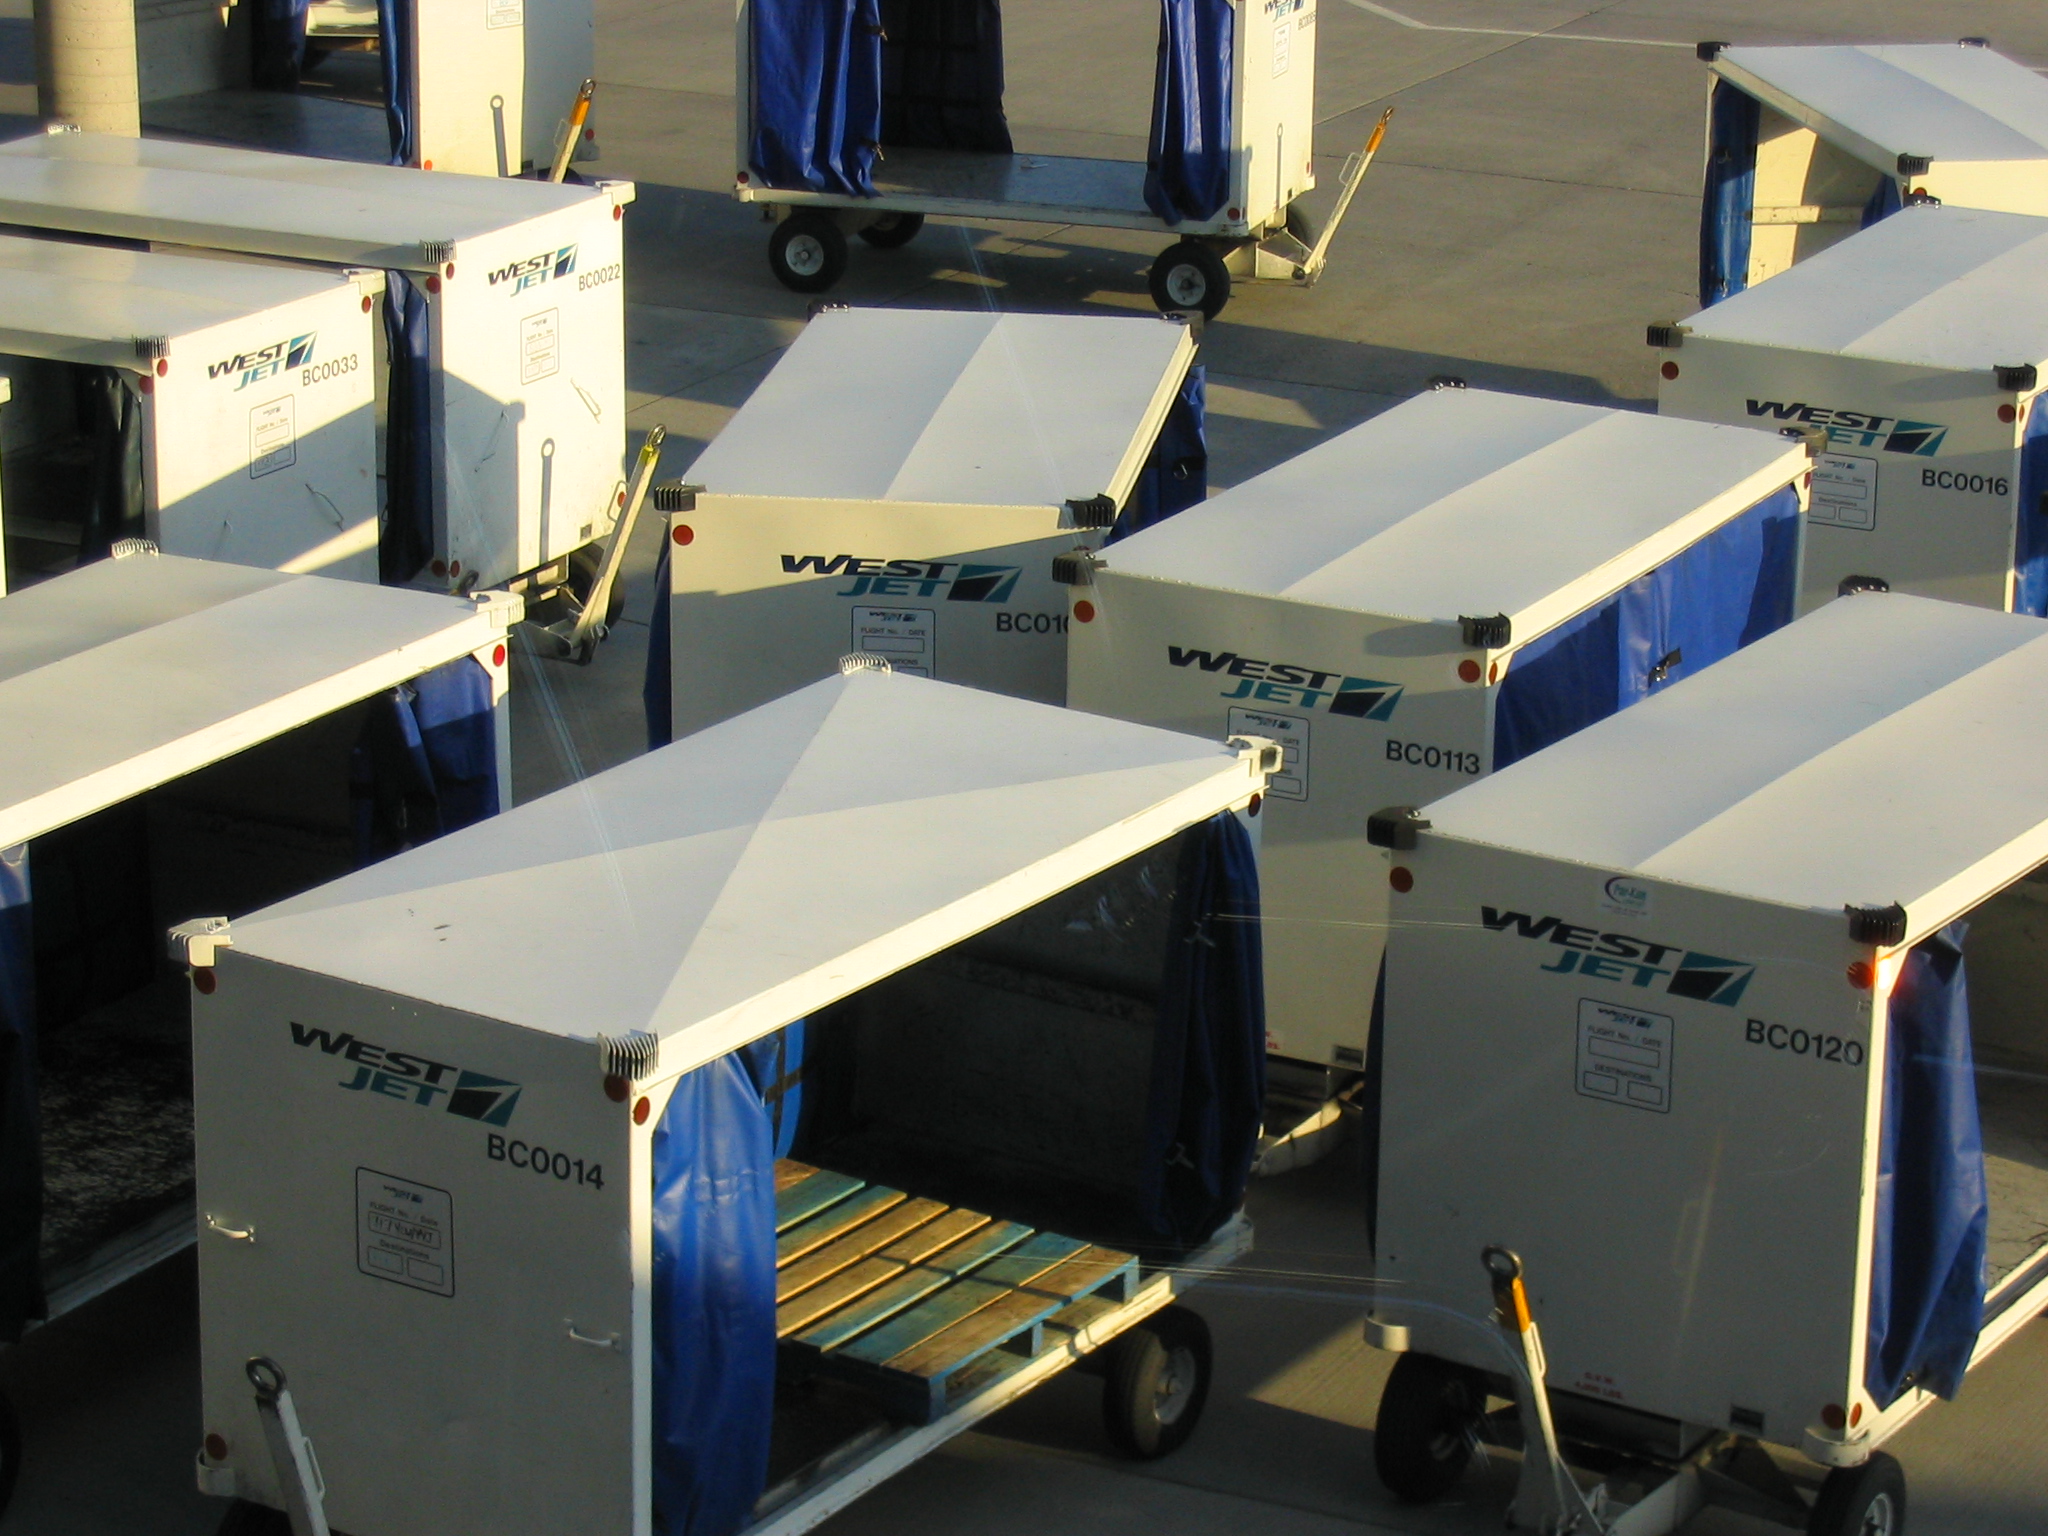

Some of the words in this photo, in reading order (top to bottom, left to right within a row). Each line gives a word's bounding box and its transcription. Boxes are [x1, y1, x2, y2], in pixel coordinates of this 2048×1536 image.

[488, 251, 551, 286] WEST
[510, 271, 550, 297] JET
[578, 264, 621, 292] BC0022
[208, 339, 289, 380] WEST
[234, 359, 285, 391] JET
[302, 354, 358, 387] BC0033
[1745, 399, 1895, 431] WEST
[1810, 424, 1888, 447] ET
[1921, 468, 2009, 496] BC0016
[781, 554, 958, 579] WEST
[836, 577, 952, 598] JET
[1168, 645, 1341, 689] WEST
[1220, 678, 1334, 708] JET
[1386, 739, 1480, 775] BC0113
[1481, 905, 1682, 965] WEST
[1540, 950, 1671, 988] JET
[290, 1021, 458, 1085] WEST
[1746, 1018, 1863, 1067] BC0120
[338, 1067, 449, 1107] JET
[487, 1133, 604, 1190] BC0014
